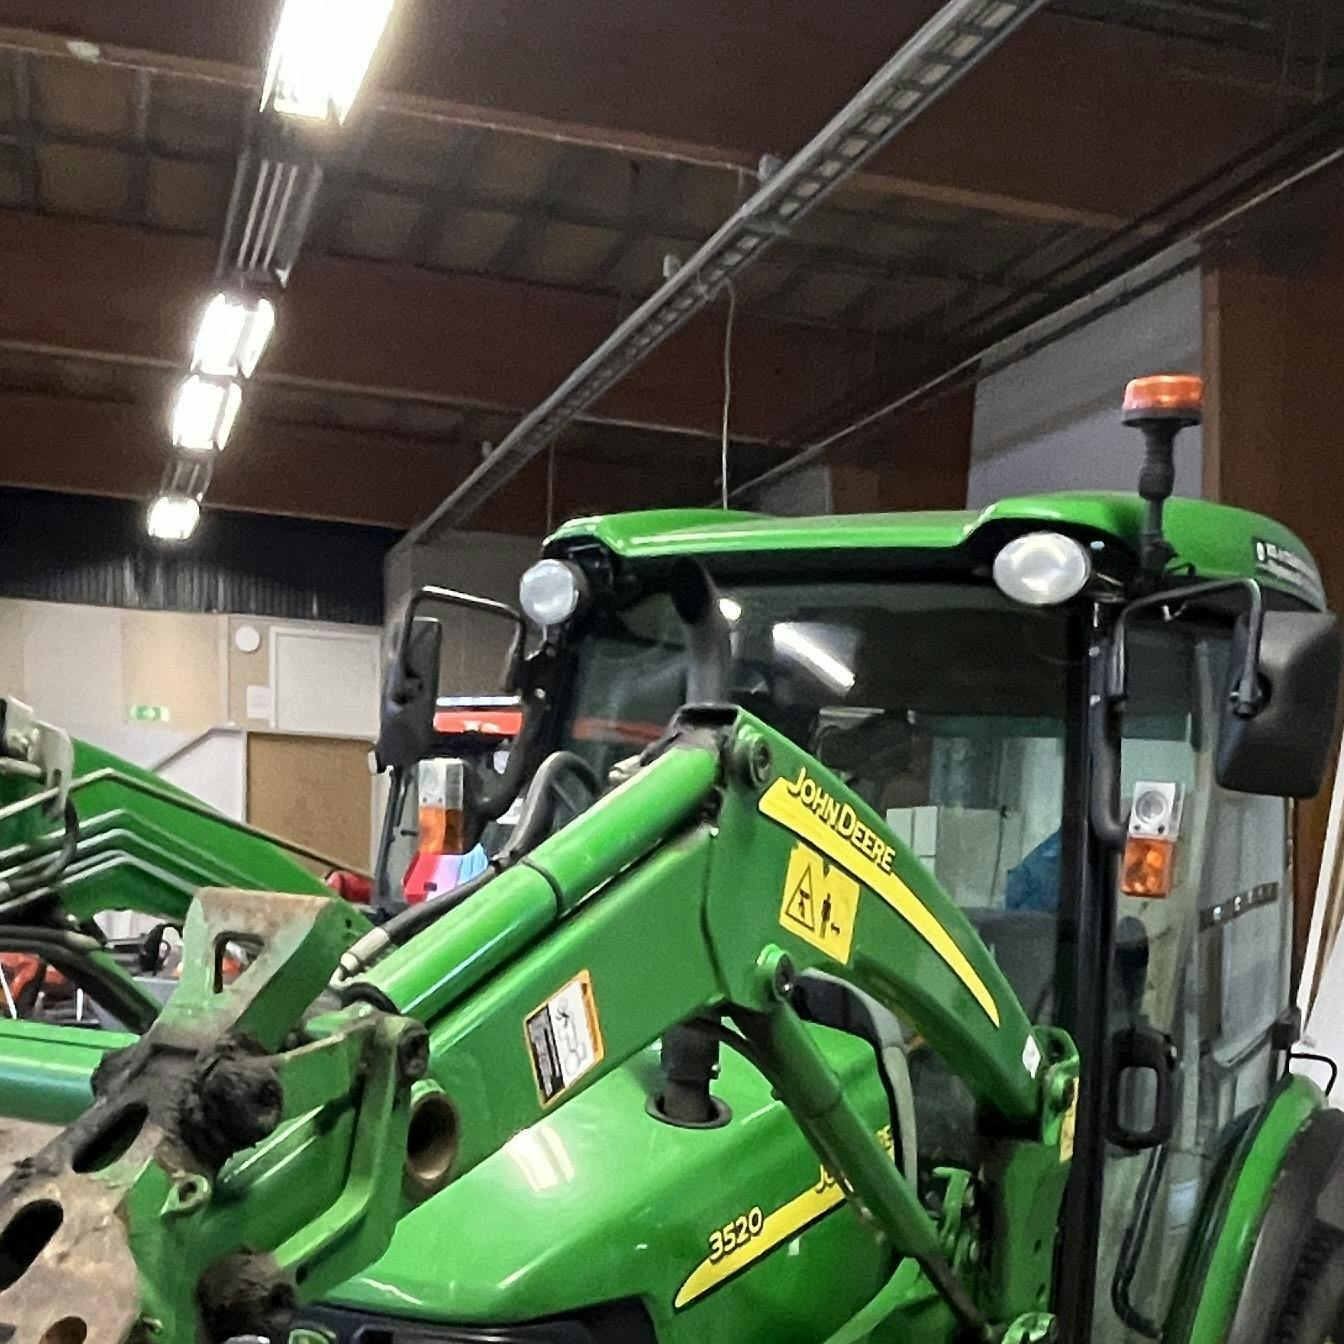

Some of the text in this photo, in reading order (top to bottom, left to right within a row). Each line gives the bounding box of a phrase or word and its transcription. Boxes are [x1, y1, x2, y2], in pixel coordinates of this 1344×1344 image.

[787, 766, 897, 875] JOHN DEERE
[708, 1206, 764, 1264] 3520
